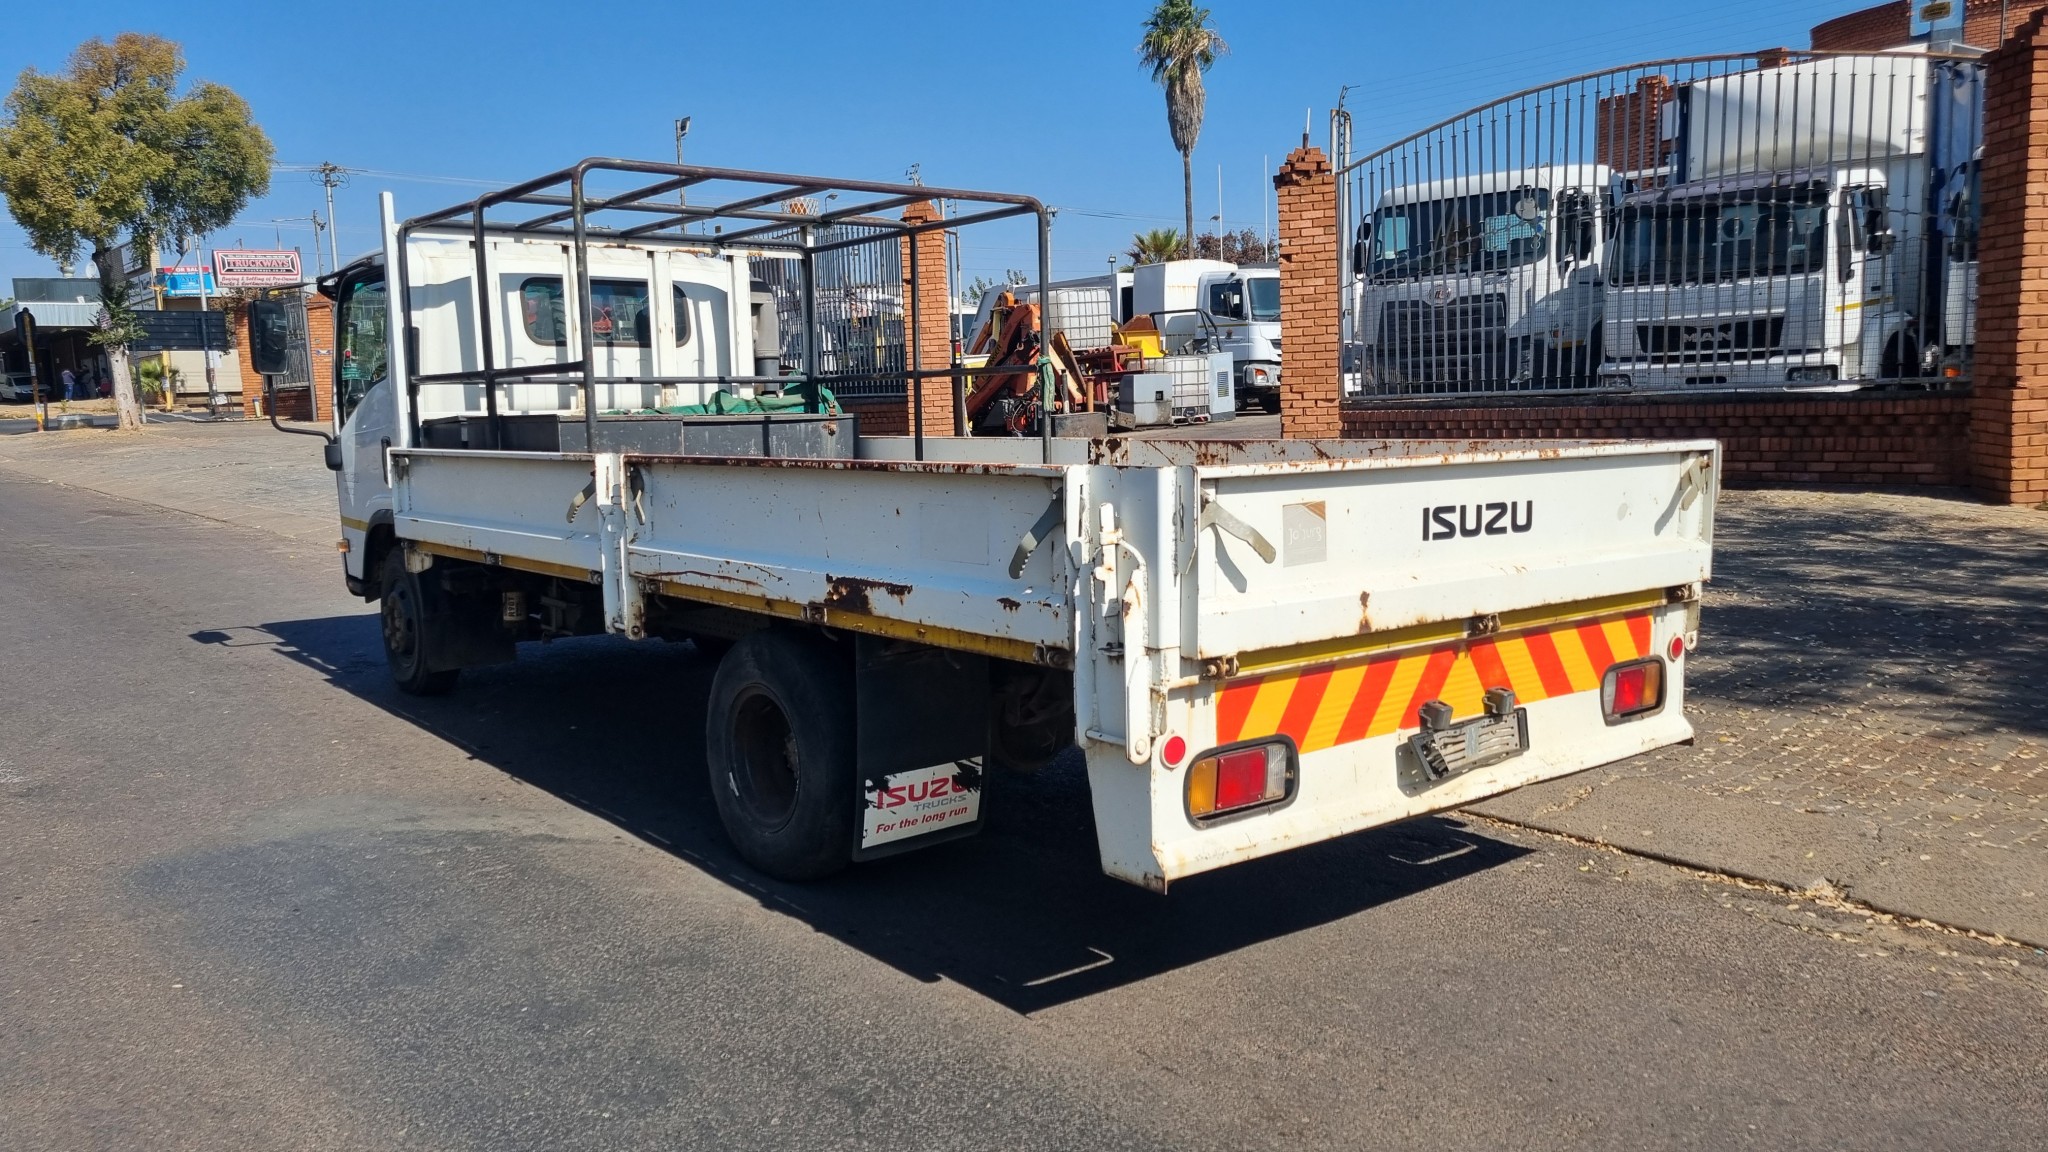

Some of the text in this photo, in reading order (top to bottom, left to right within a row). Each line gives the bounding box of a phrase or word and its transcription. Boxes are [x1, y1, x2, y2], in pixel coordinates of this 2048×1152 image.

[227, 259, 290, 268] TRUCKWAYS
[1682, 331, 1733, 342] MAN
[1422, 500, 1533, 541] ISUZU
[913, 794, 967, 812] TRUCKS
[876, 806, 968, 834] For the long run
